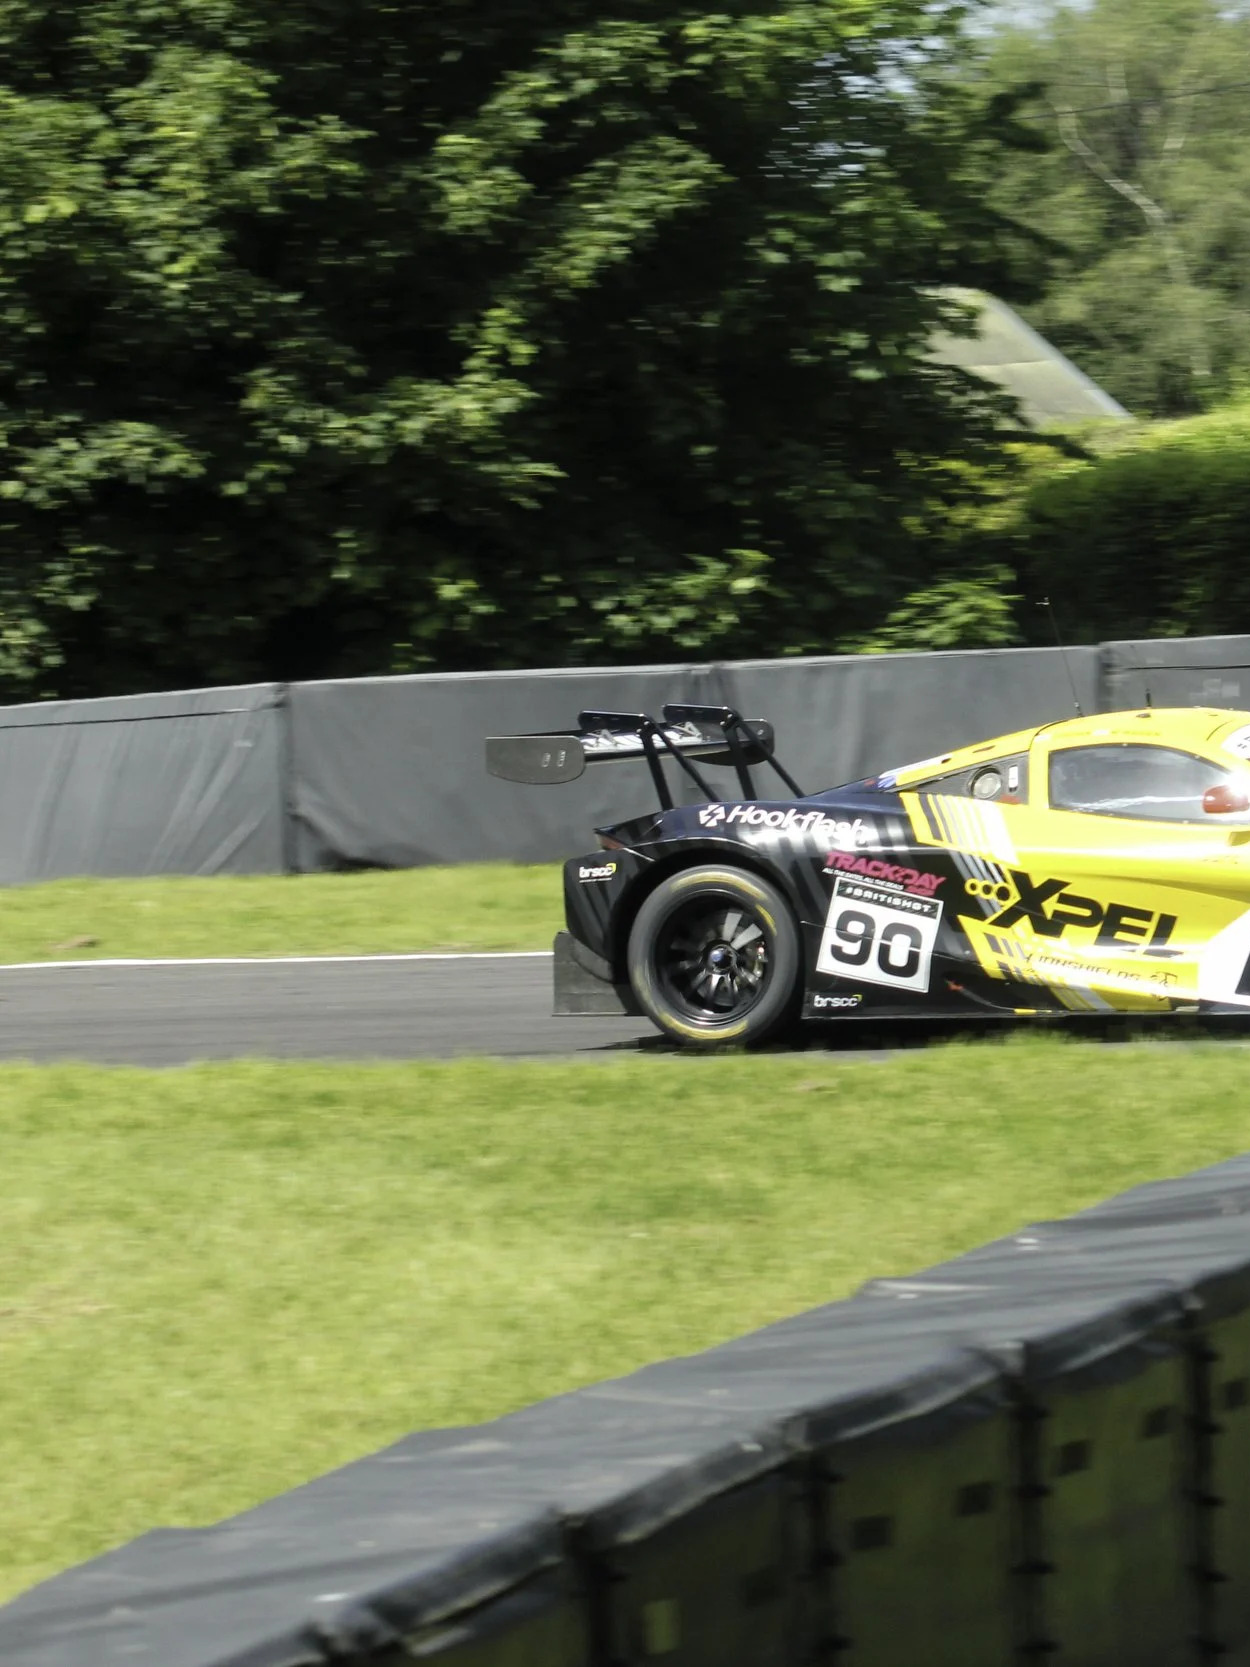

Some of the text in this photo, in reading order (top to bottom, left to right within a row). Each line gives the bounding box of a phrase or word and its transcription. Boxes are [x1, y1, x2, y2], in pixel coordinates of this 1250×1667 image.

[726, 805, 870, 844] Hookflash
[988, 869, 1184, 958] XPEL
[830, 909, 922, 978] 90
[814, 994, 858, 1007] brscc
